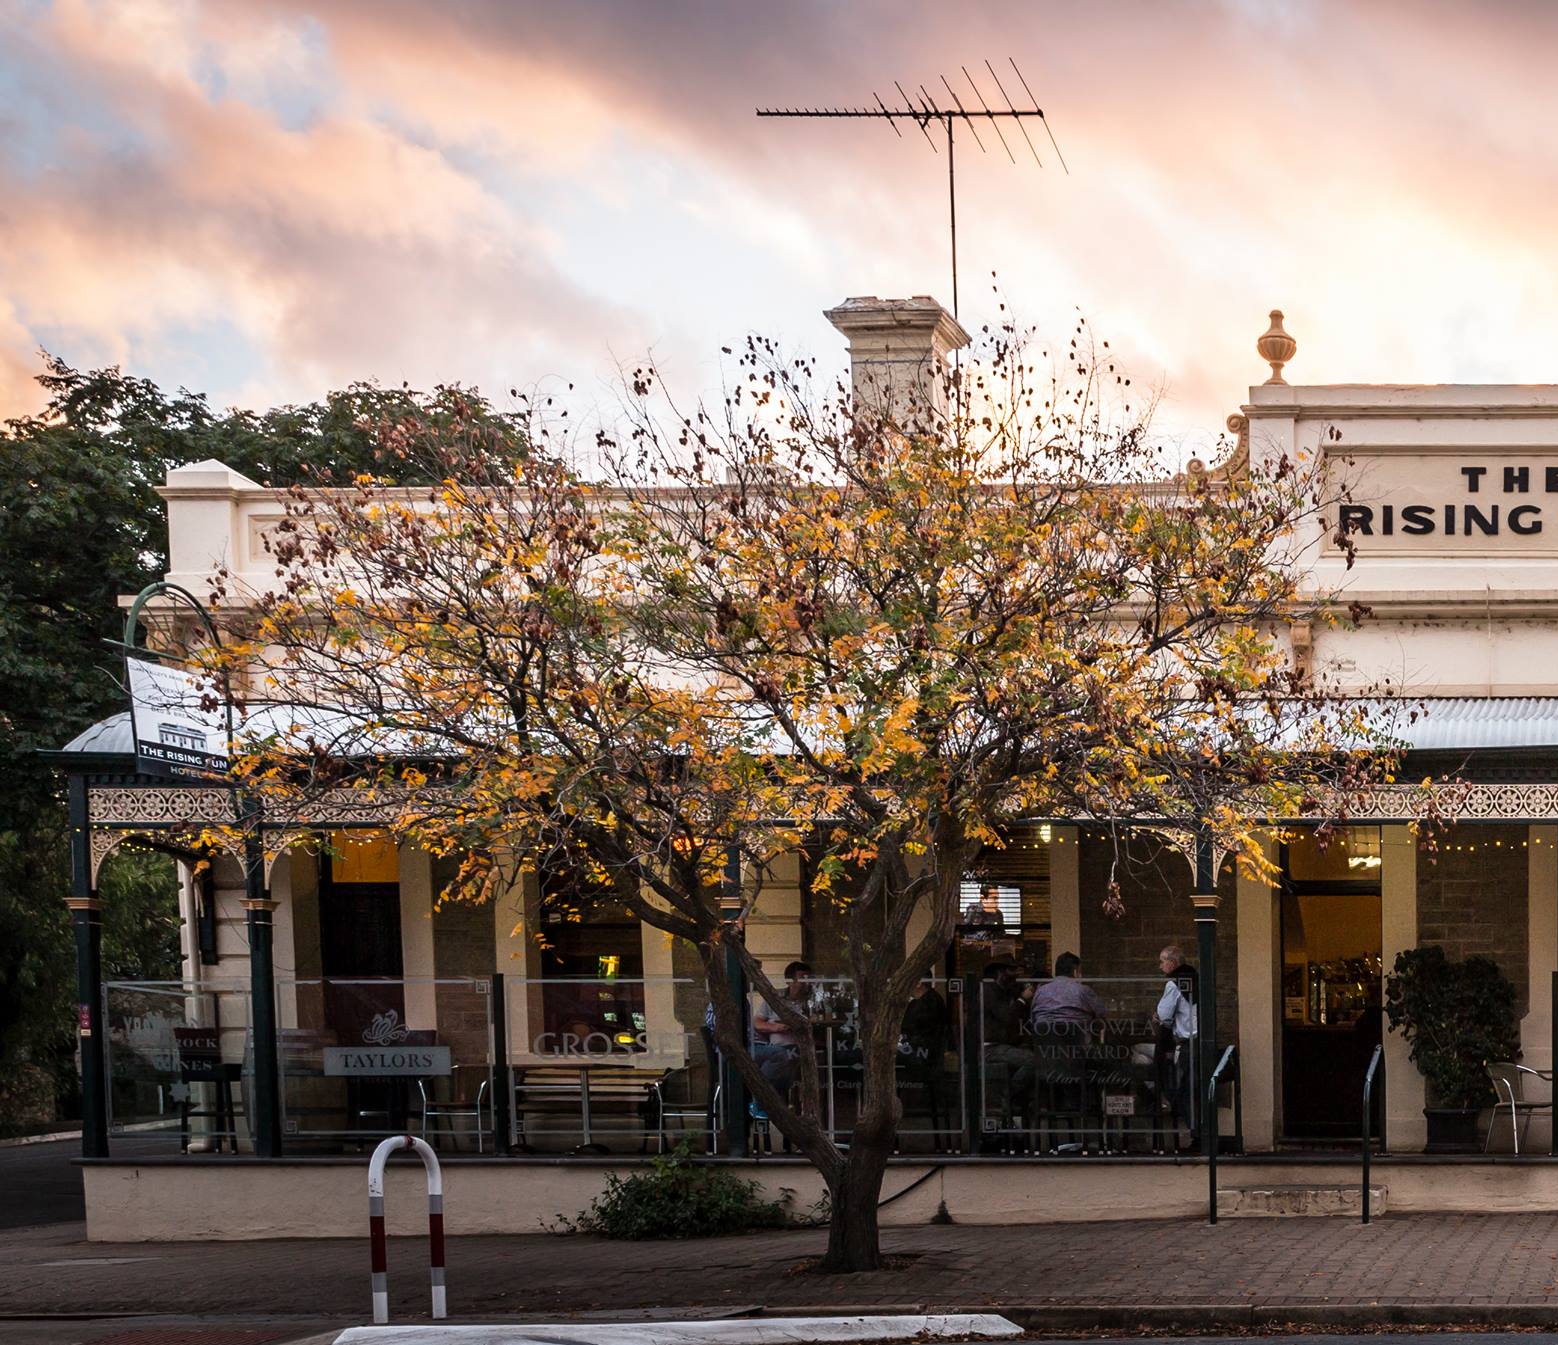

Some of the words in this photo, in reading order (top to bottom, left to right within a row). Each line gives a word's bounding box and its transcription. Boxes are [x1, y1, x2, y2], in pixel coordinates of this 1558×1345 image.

[1339, 505, 1543, 535] RISING
[140, 745, 165, 758] THE
[167, 751, 203, 765] RISING
[205, 757, 228, 769] UN
[170, 766, 203, 779] HOTEL
[1018, 1018, 1156, 1036] KOONOWLA
[533, 1032, 697, 1059] GROSSET
[1038, 1045, 1136, 1059] VINEYARDS
[340, 1054, 433, 1068] TAYLORS
